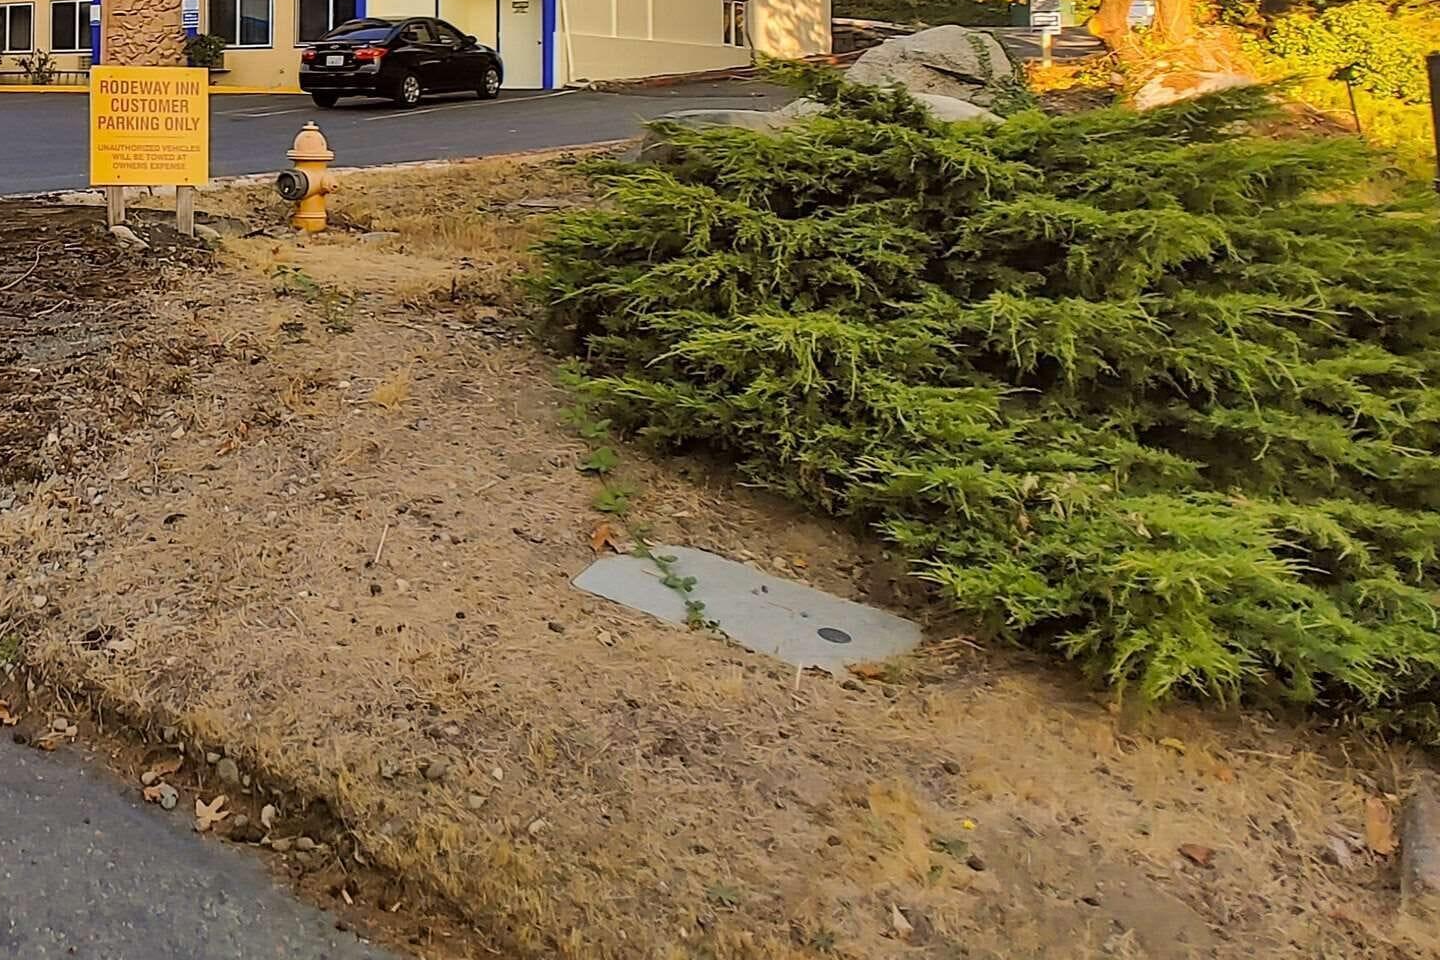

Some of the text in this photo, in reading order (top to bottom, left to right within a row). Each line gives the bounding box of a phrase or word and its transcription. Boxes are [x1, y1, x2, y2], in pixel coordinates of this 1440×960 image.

[100, 80, 199, 96] RODEWAY INN
[111, 98, 189, 113] CUSTOMER
[98, 116, 200, 131] PARKING ONLY
